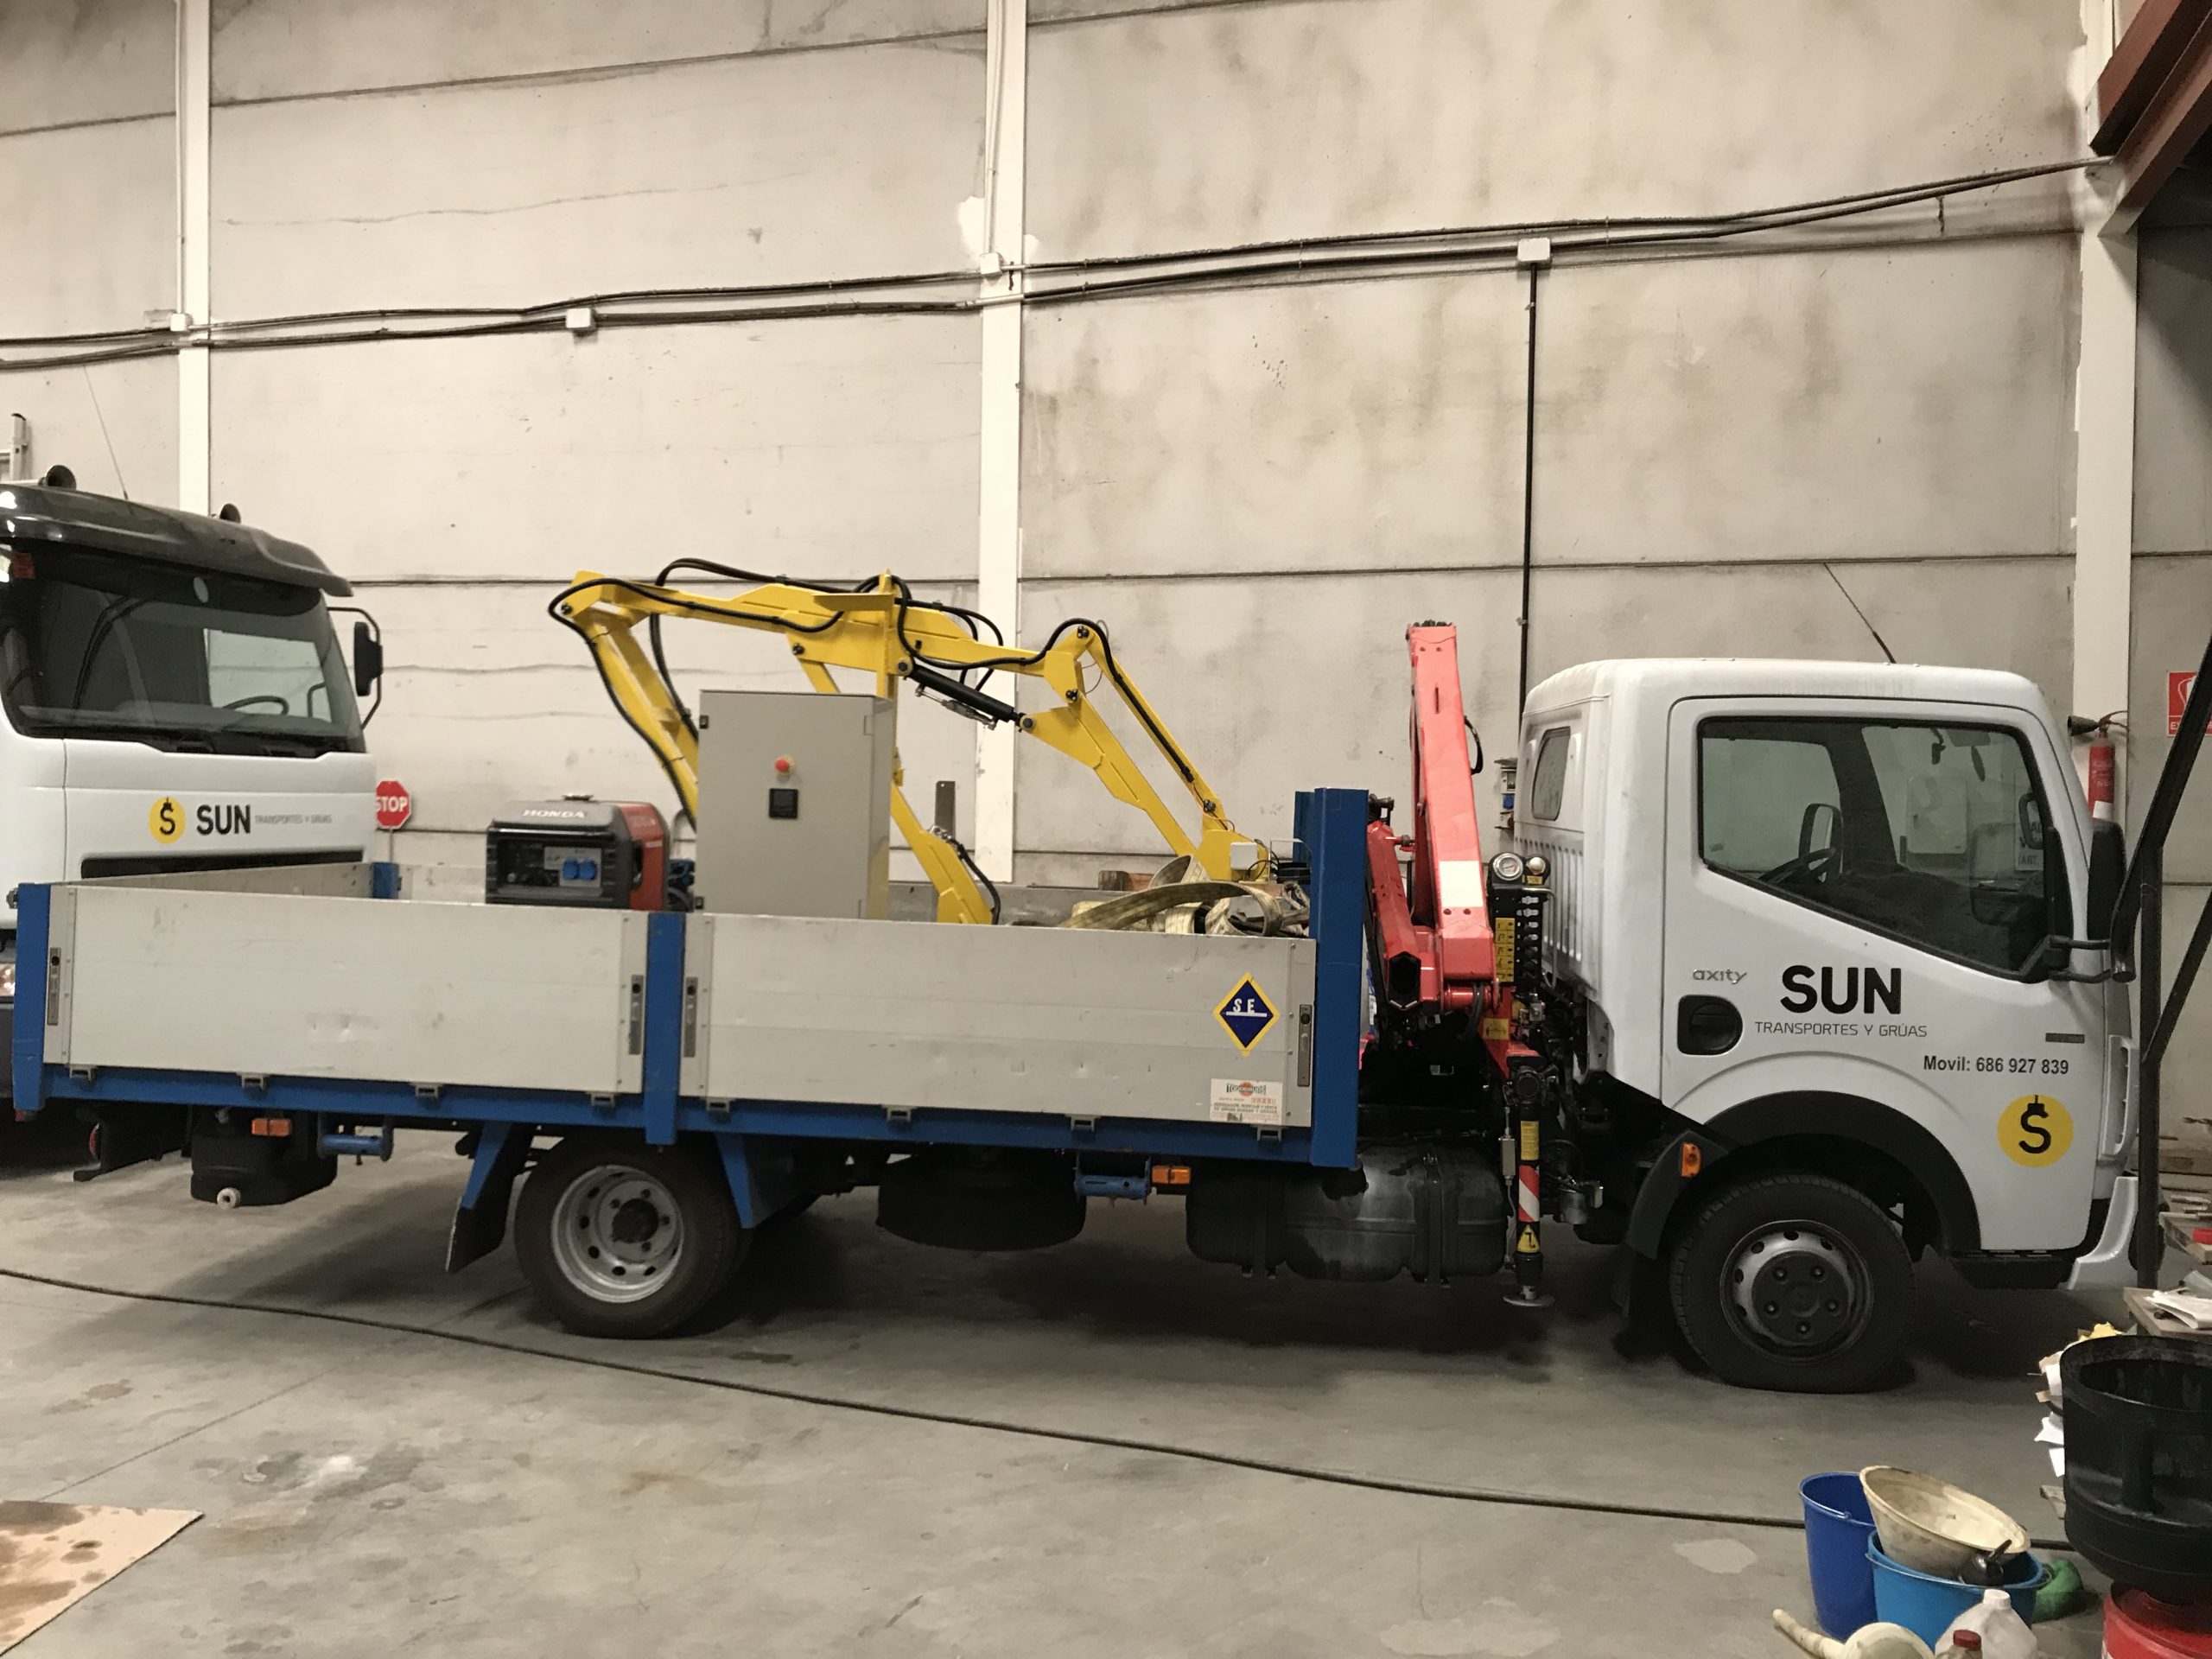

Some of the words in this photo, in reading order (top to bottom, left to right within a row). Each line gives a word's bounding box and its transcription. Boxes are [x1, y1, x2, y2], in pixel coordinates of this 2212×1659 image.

[375, 794, 408, 813] STOP
[195, 804, 251, 836] SUN
[522, 809, 586, 819] HONDA
[1692, 969, 1748, 984] axity
[1780, 964, 1902, 1014] SUN
[1754, 1021, 1858, 1036] TRANSPORTES
[1864, 1024, 1874, 1036] Y
[1878, 1023, 1928, 1038] GRÚAS
[1923, 1055, 1970, 1071] Movil:
[1976, 1057, 2004, 1072] 686
[2008, 1058, 2037, 1073] 927
[2041, 1059, 2069, 1074] 839
